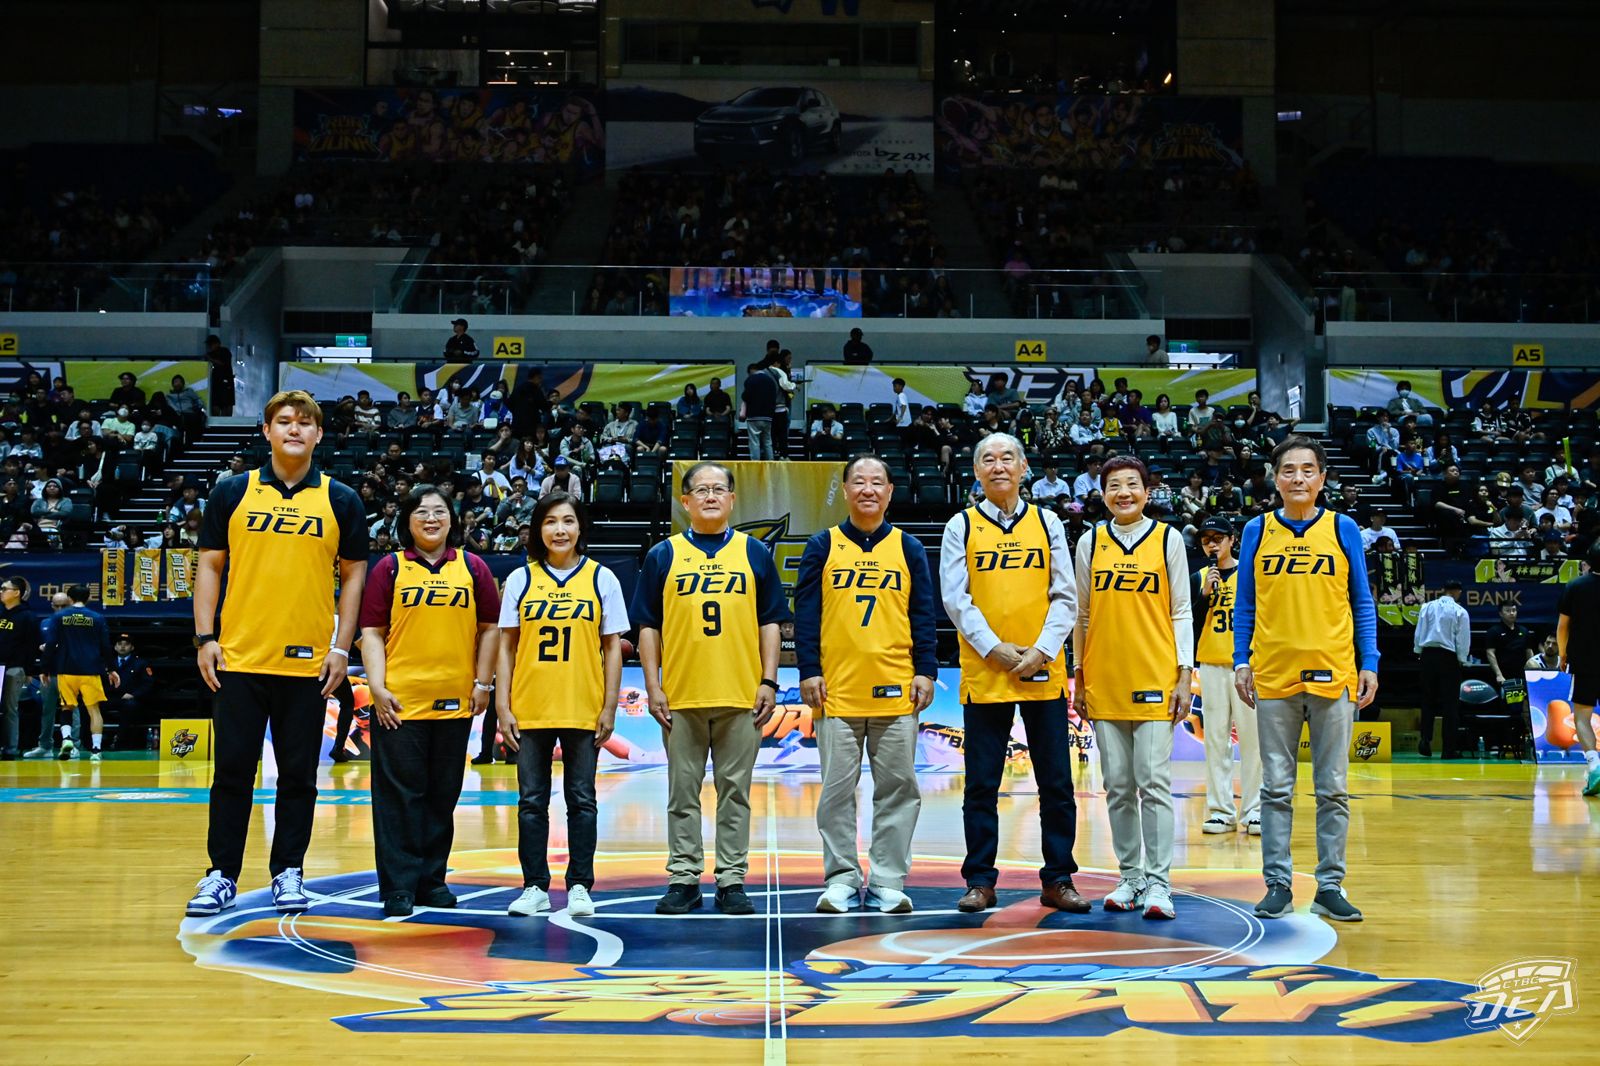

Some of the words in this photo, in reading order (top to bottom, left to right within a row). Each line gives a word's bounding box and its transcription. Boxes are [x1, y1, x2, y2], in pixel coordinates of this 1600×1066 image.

[496, 342, 522, 355] A3
[1017, 344, 1044, 357] A4
[1515, 349, 1541, 362] A5
[246, 509, 323, 538] DEA
[975, 550, 1044, 570] DEA
[1262, 554, 1335, 576] DEA
[676, 572, 747, 595] DEA
[833, 570, 900, 591] DEA
[1094, 571, 1158, 593] DEA
[401, 588, 469, 608] DEA
[1466, 590, 1522, 607] BANK
[523, 598, 594, 621] DEA
[702, 601, 722, 637] 9
[856, 596, 876, 626] 7
[539, 626, 571, 661] 21
